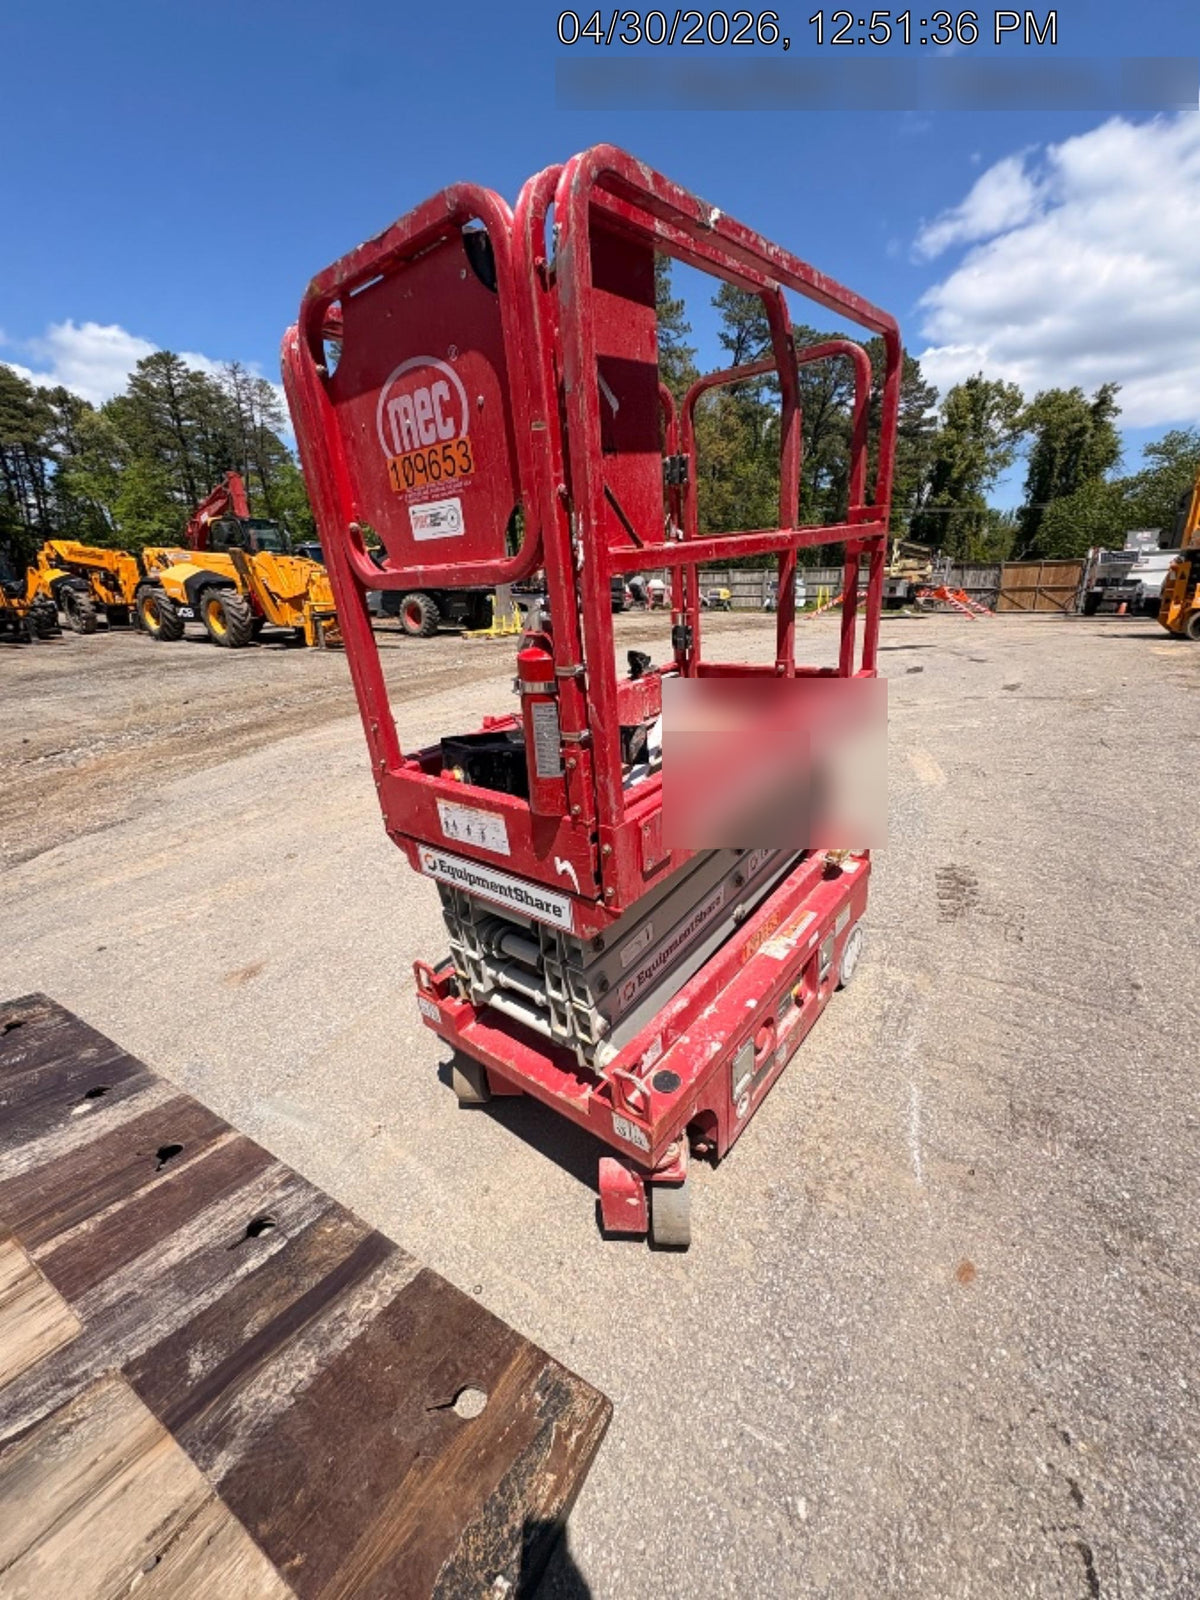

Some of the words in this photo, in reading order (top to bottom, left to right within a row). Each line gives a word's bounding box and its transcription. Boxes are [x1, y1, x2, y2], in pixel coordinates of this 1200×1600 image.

[390, 440, 473, 490] 109653
[437, 859, 563, 918] EquipmentShare
[636, 896, 721, 987] EquipmentShare
